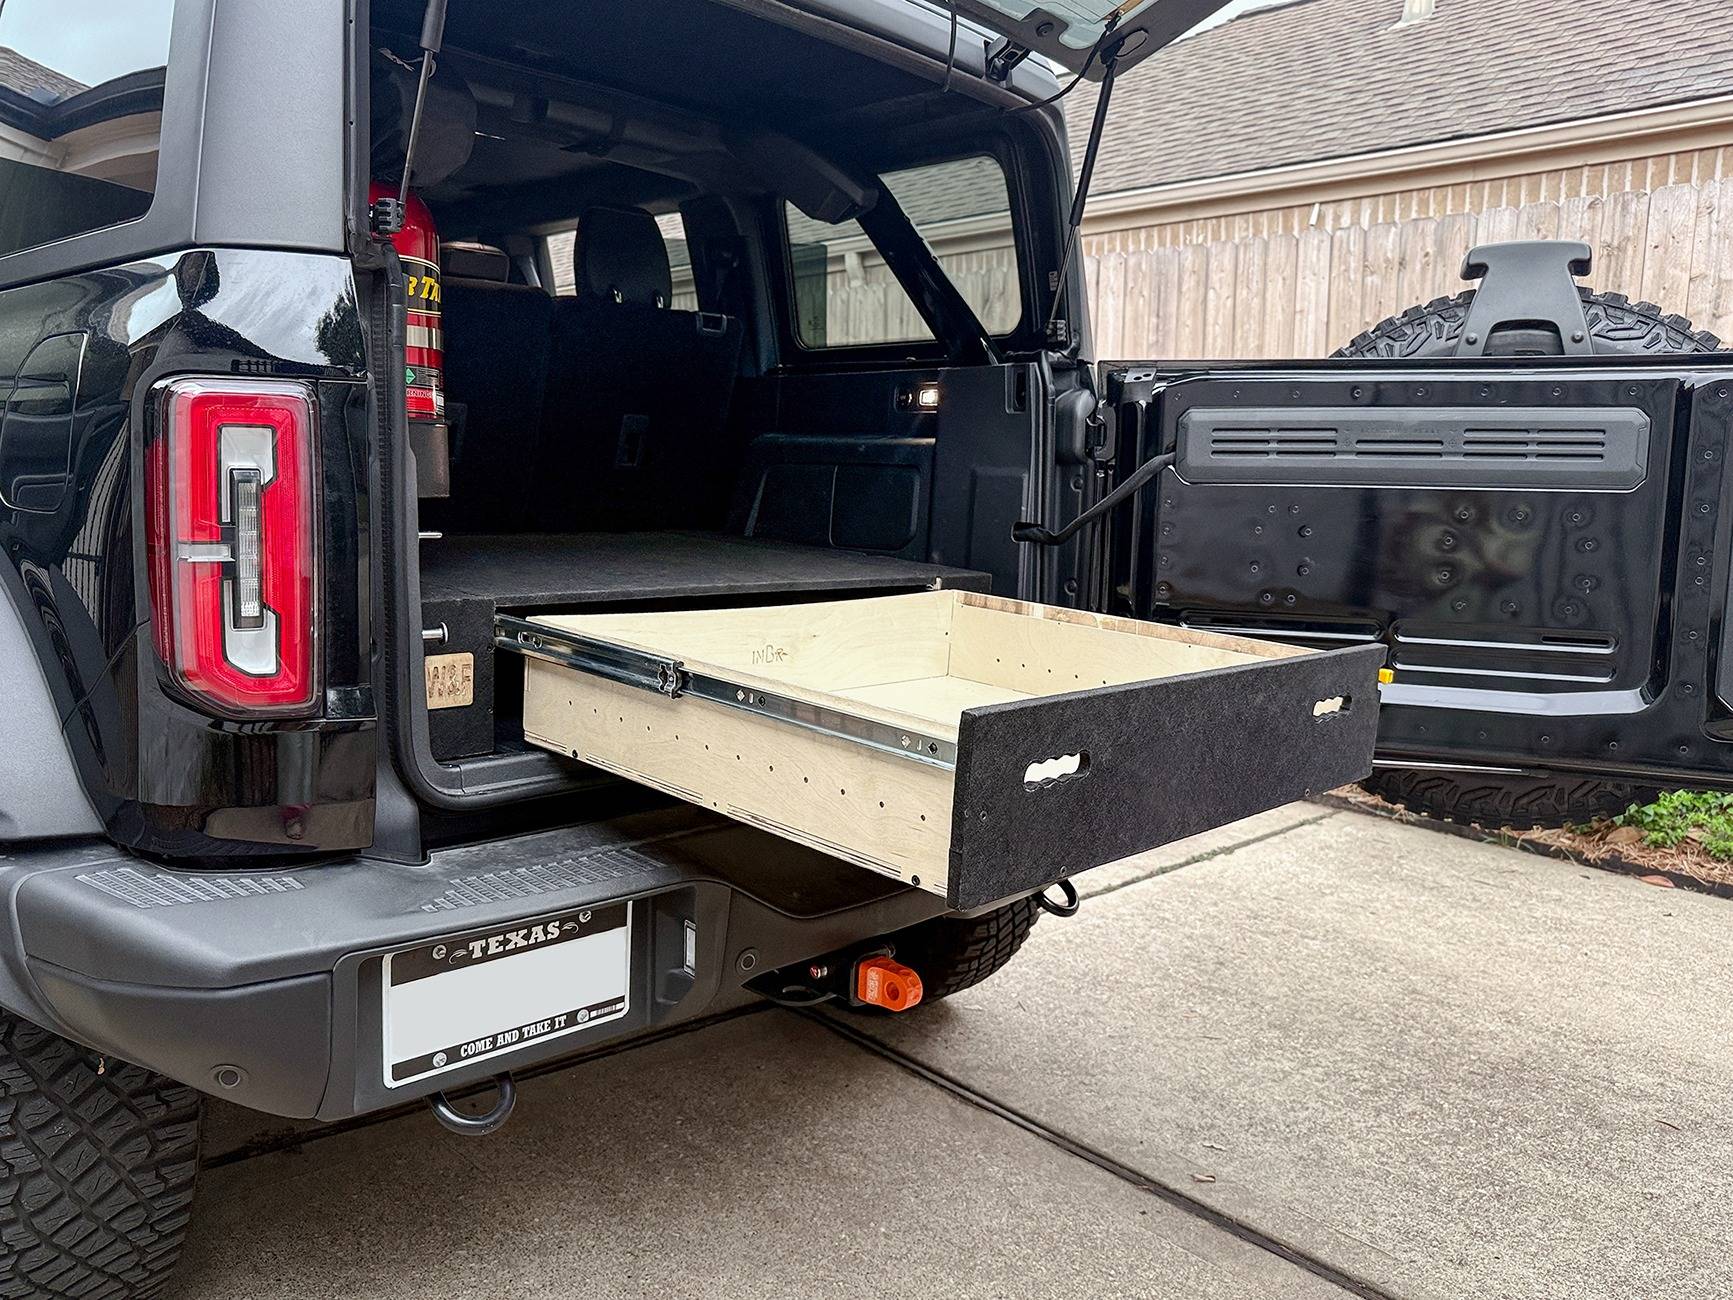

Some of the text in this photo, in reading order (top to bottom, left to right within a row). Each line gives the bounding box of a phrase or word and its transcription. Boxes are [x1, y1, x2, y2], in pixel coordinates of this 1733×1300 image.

[469, 920, 561, 959] TEXAS
[460, 1015, 567, 1057] COME AND TAKE IT
